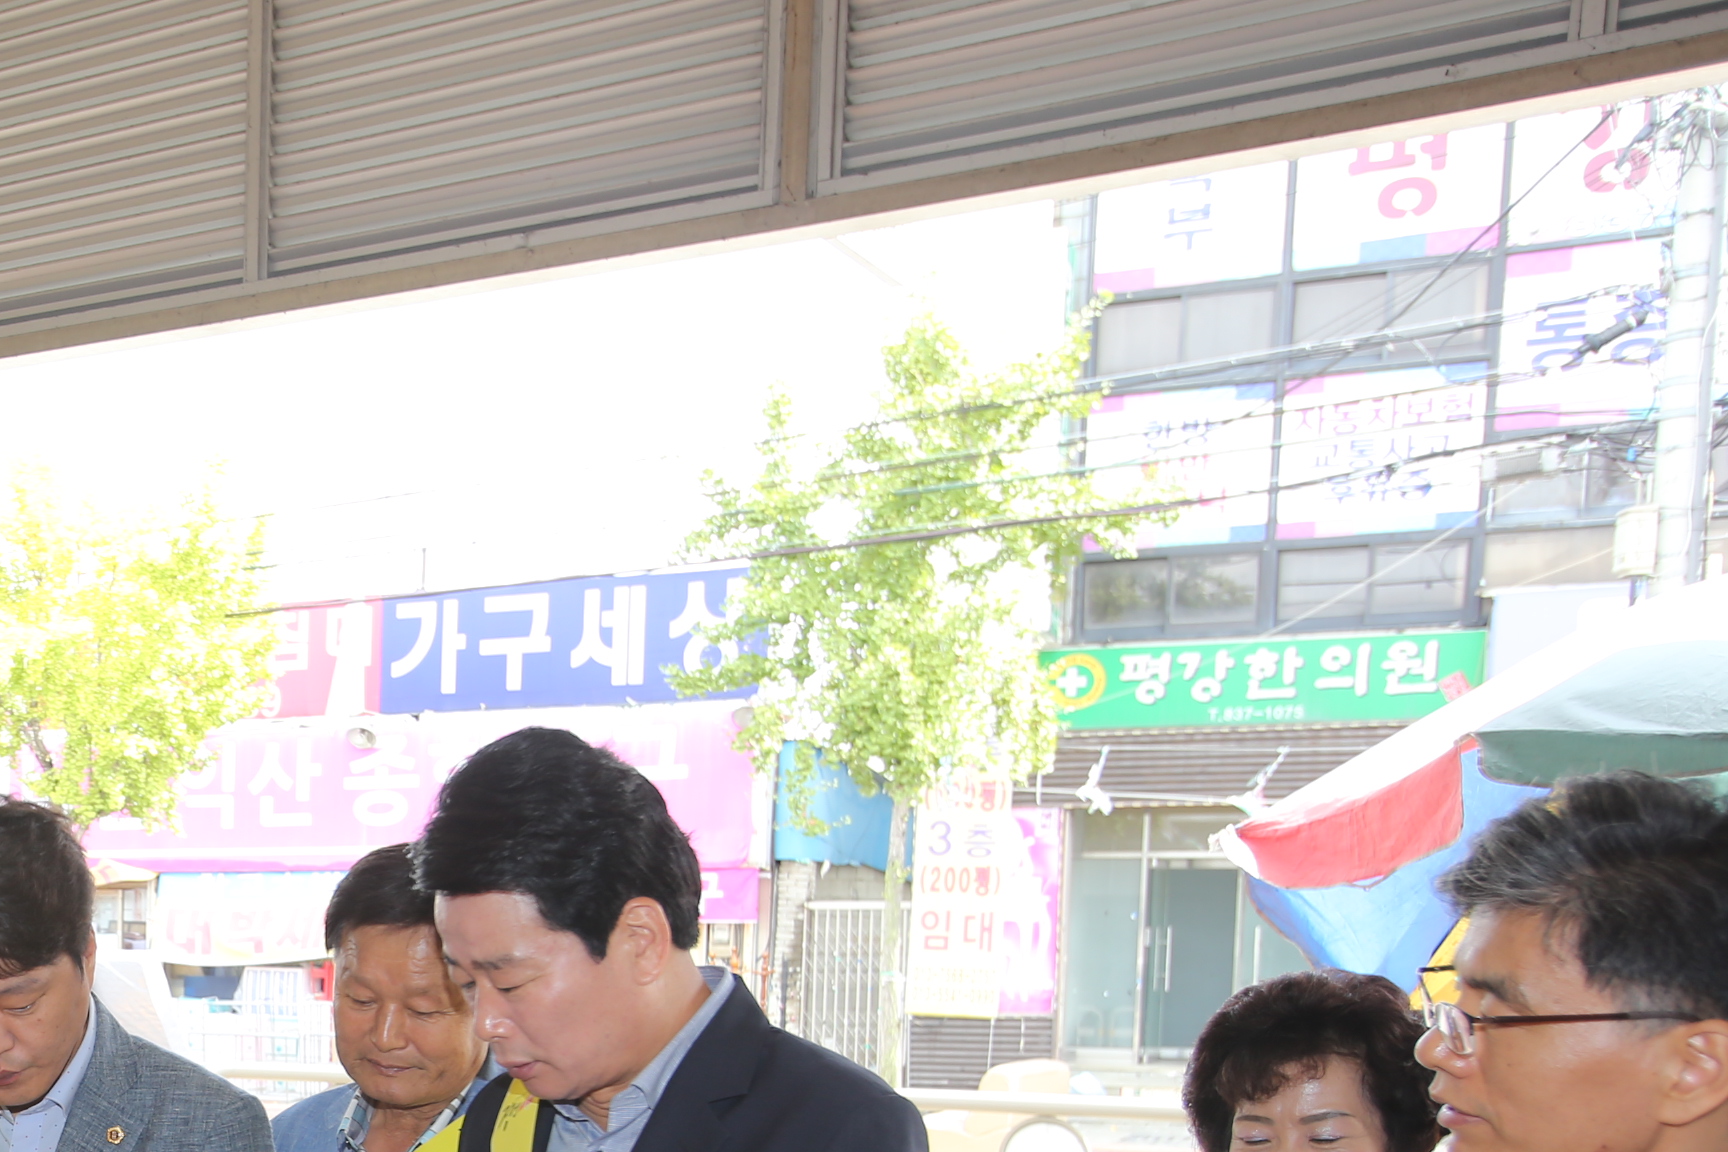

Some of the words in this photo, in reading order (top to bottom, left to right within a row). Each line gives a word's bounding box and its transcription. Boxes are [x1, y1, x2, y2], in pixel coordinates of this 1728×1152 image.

[1293, 392, 1474, 436] 자동차보험
[389, 575, 751, 695] 가구세상
[1118, 638, 1441, 705] 평강한의원
[920, 910, 995, 953] 임대
